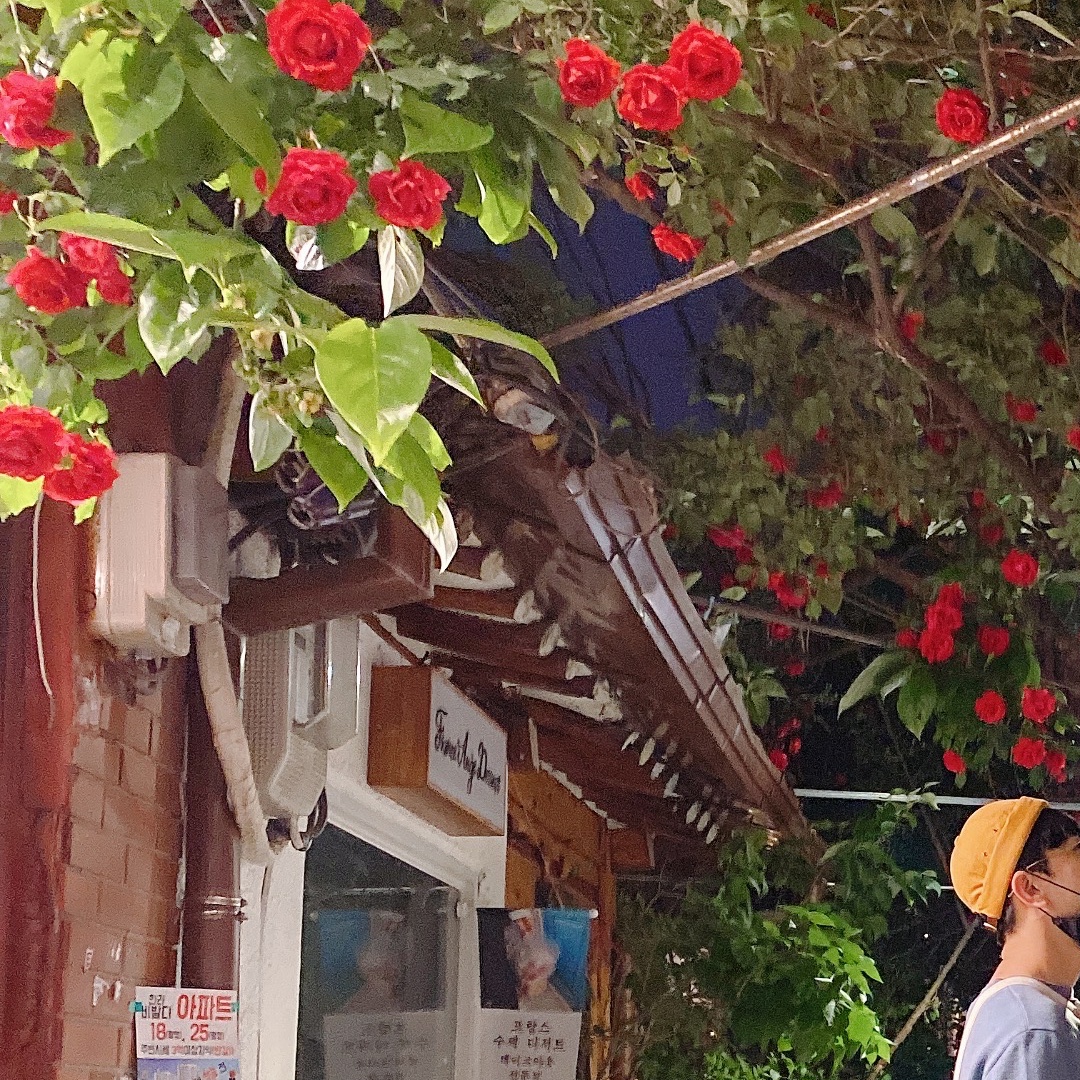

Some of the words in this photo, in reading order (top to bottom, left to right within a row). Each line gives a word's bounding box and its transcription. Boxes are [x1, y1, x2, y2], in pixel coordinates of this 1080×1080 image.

[177, 994, 232, 1020] 아파트
[511, 1020, 551, 1035] 프랑스
[527, 1036, 566, 1052] 디저트
